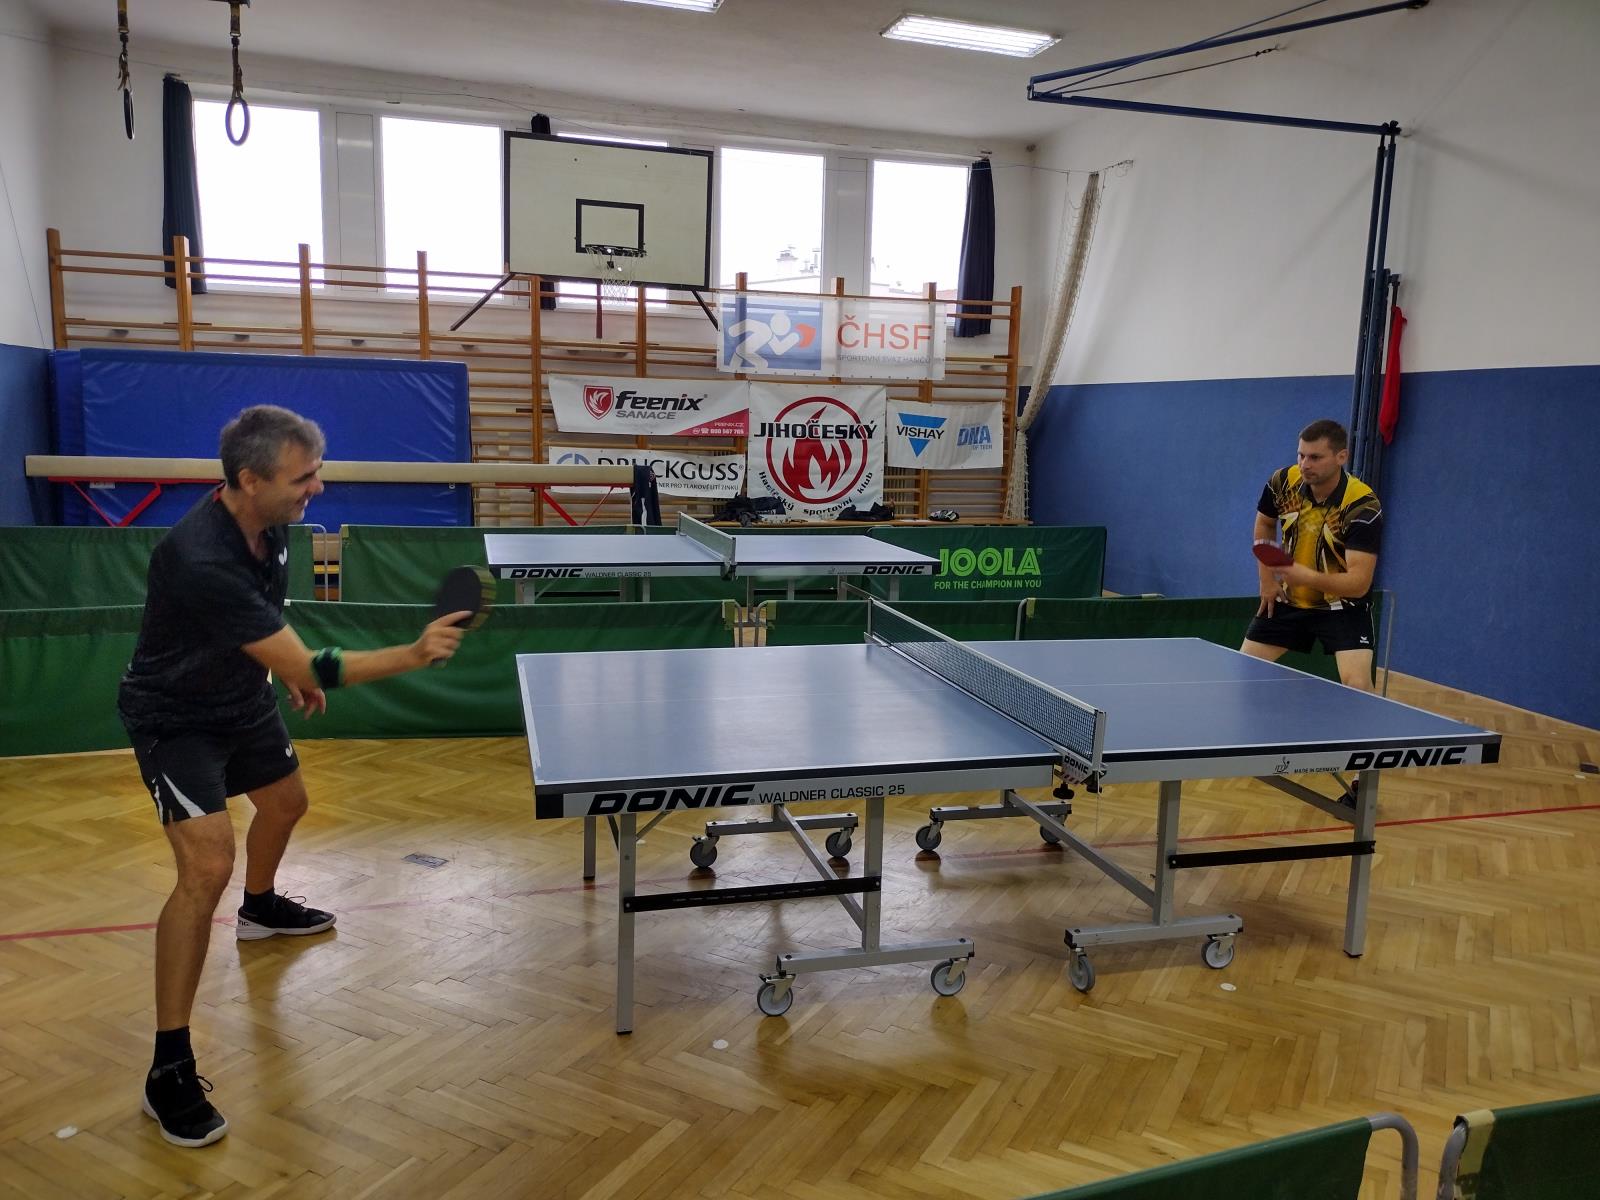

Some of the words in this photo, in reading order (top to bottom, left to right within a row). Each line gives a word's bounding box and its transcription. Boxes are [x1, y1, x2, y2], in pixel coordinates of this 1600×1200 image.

[837, 314, 933, 350] ČHSF
[614, 390, 705, 411] feenix
[615, 410, 677, 420] SANACE
[753, 420, 878, 439] JIHOČESKÝ
[896, 425, 945, 440] VISHAY
[956, 425, 992, 446] DNA
[803, 497, 853, 516] sportovní
[856, 471, 873, 494] klub
[863, 566, 925, 575] DONIC
[939, 547, 1041, 577] JOOLA
[510, 568, 583, 578] DONIC
[934, 581, 951, 590] FOR
[953, 581, 969, 589] THE
[971, 580, 1013, 589] CHAMPION
[1014, 580, 1022, 588] IN
[1024, 580, 1042, 588] YOU
[1063, 754, 1090, 775] DONIC
[1344, 746, 1468, 771] DONIC
[587, 783, 755, 815] DONIC
[758, 788, 826, 804] WALDNER
[830, 785, 885, 800] CLASSIC
[888, 784, 905, 796] 25
